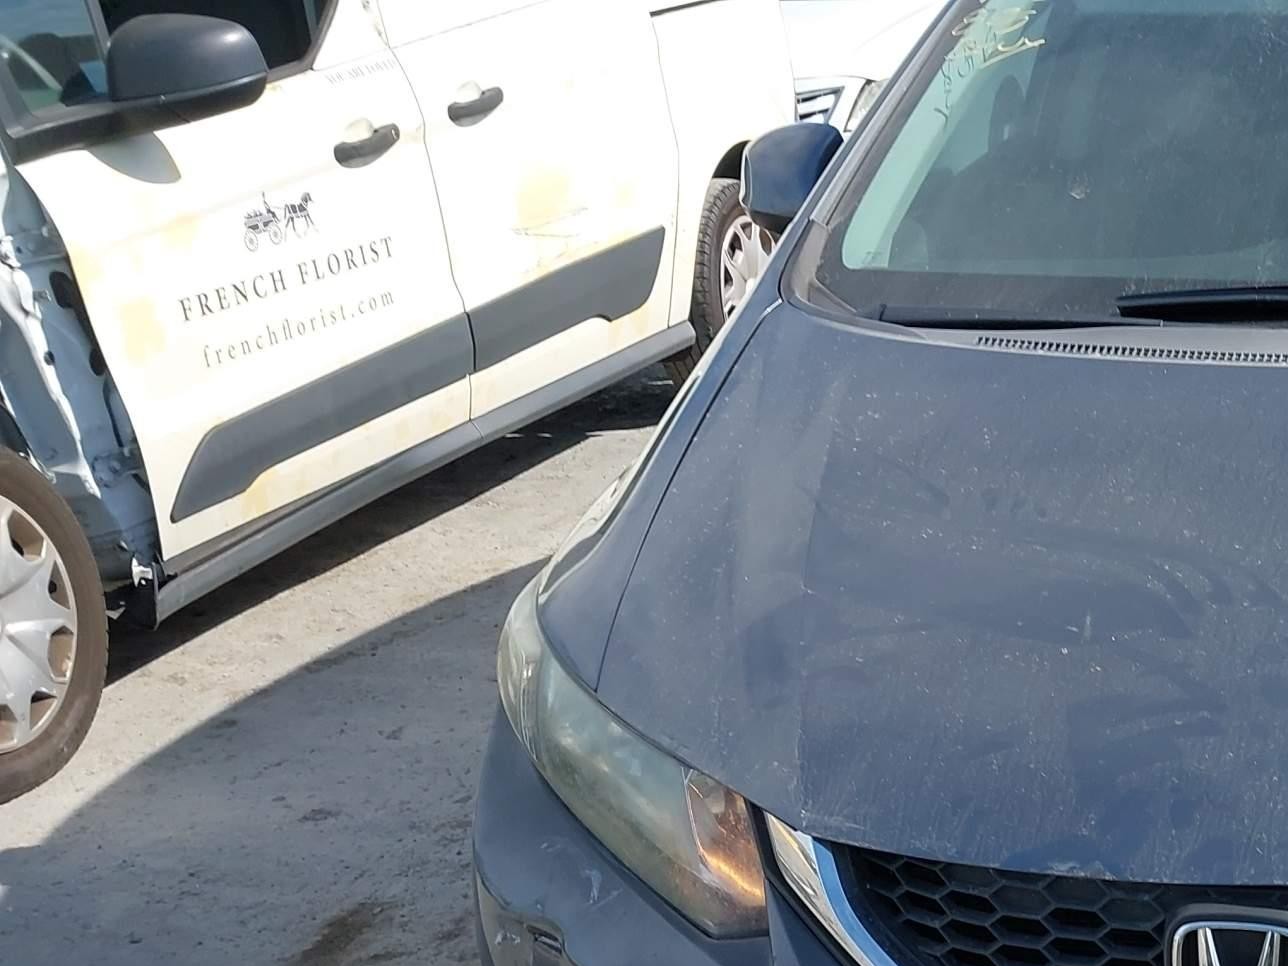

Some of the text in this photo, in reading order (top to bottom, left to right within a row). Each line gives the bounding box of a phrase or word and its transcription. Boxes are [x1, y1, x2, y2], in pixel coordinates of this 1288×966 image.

[178, 236, 394, 322] FRENCH FLORIST
[204, 290, 395, 368] frenchflorist.com
